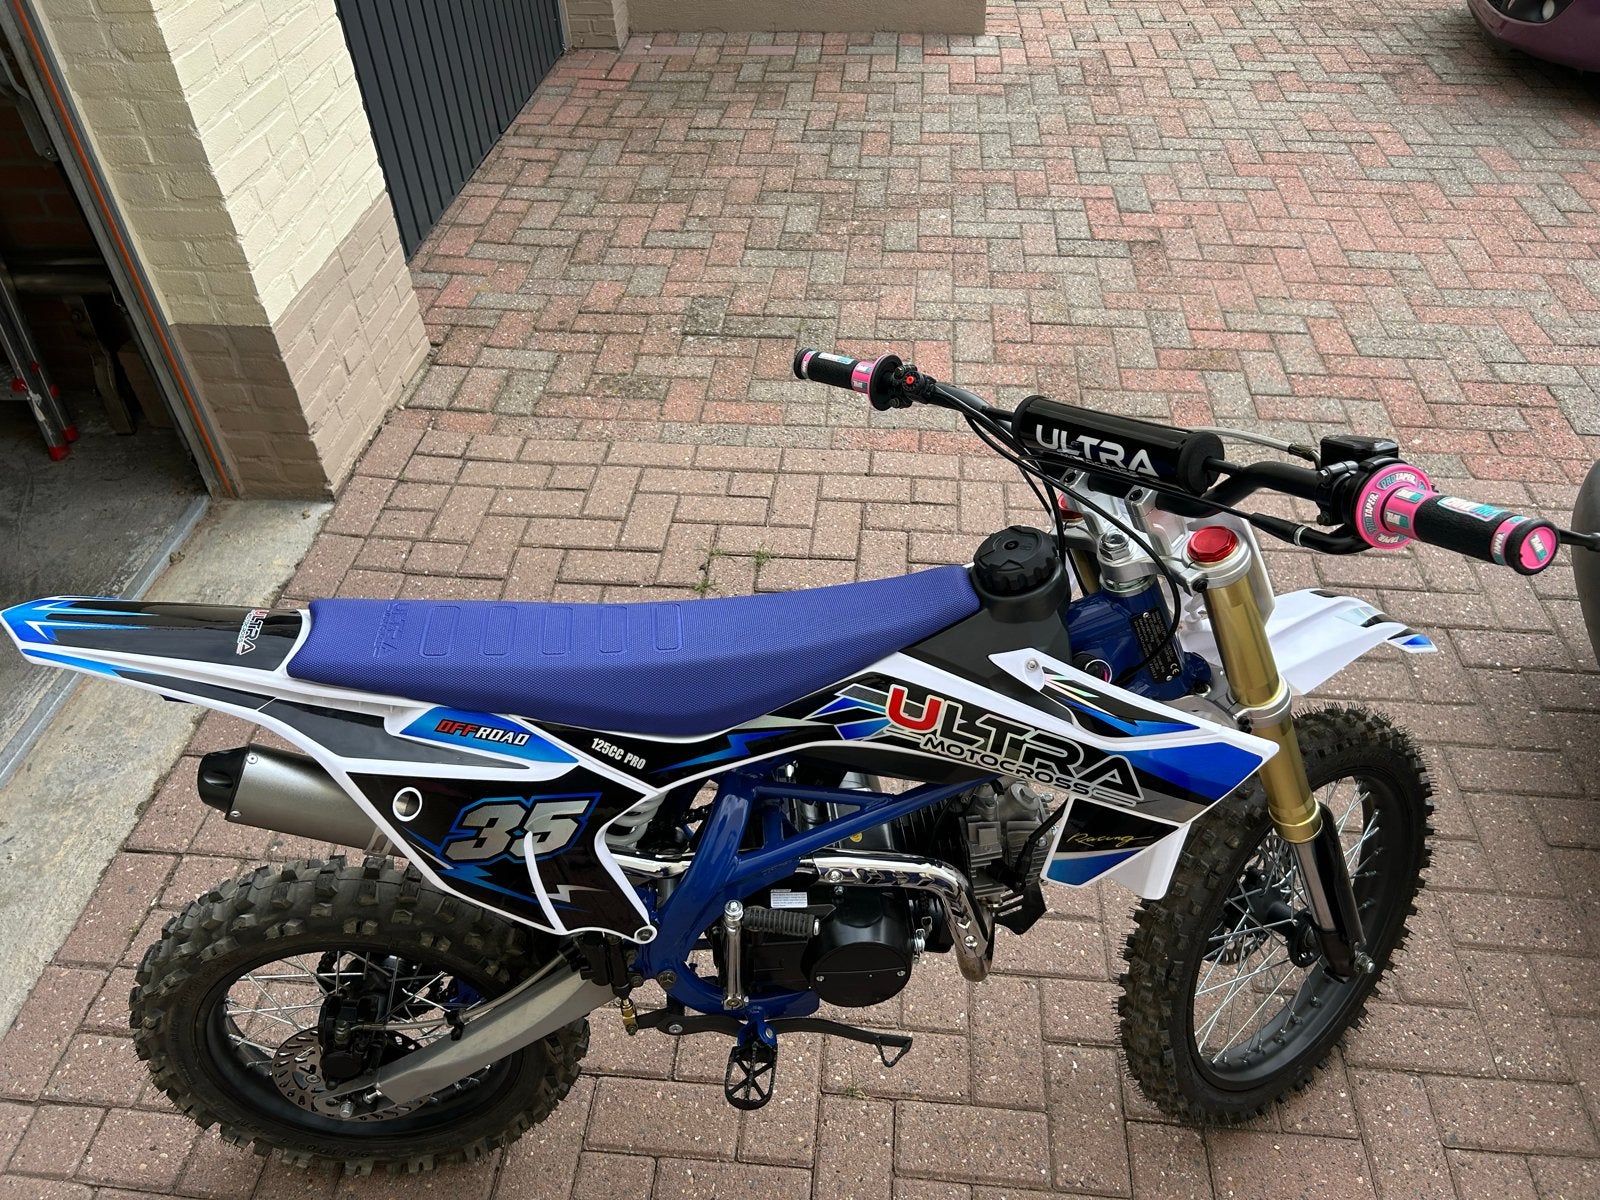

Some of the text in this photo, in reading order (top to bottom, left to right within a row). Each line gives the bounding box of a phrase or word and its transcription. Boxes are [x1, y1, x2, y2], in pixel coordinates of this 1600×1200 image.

[1036, 424, 1160, 478] ULTRA
[240, 609, 270, 655] ULTRA
[435, 718, 532, 747] OFFROAD
[590, 737, 647, 771] 125CC PRO
[886, 683, 1146, 801] ULTRA
[919, 735, 1093, 796] MOTOCROSS
[443, 799, 592, 863] 35
[1065, 831, 1142, 848] Racing
